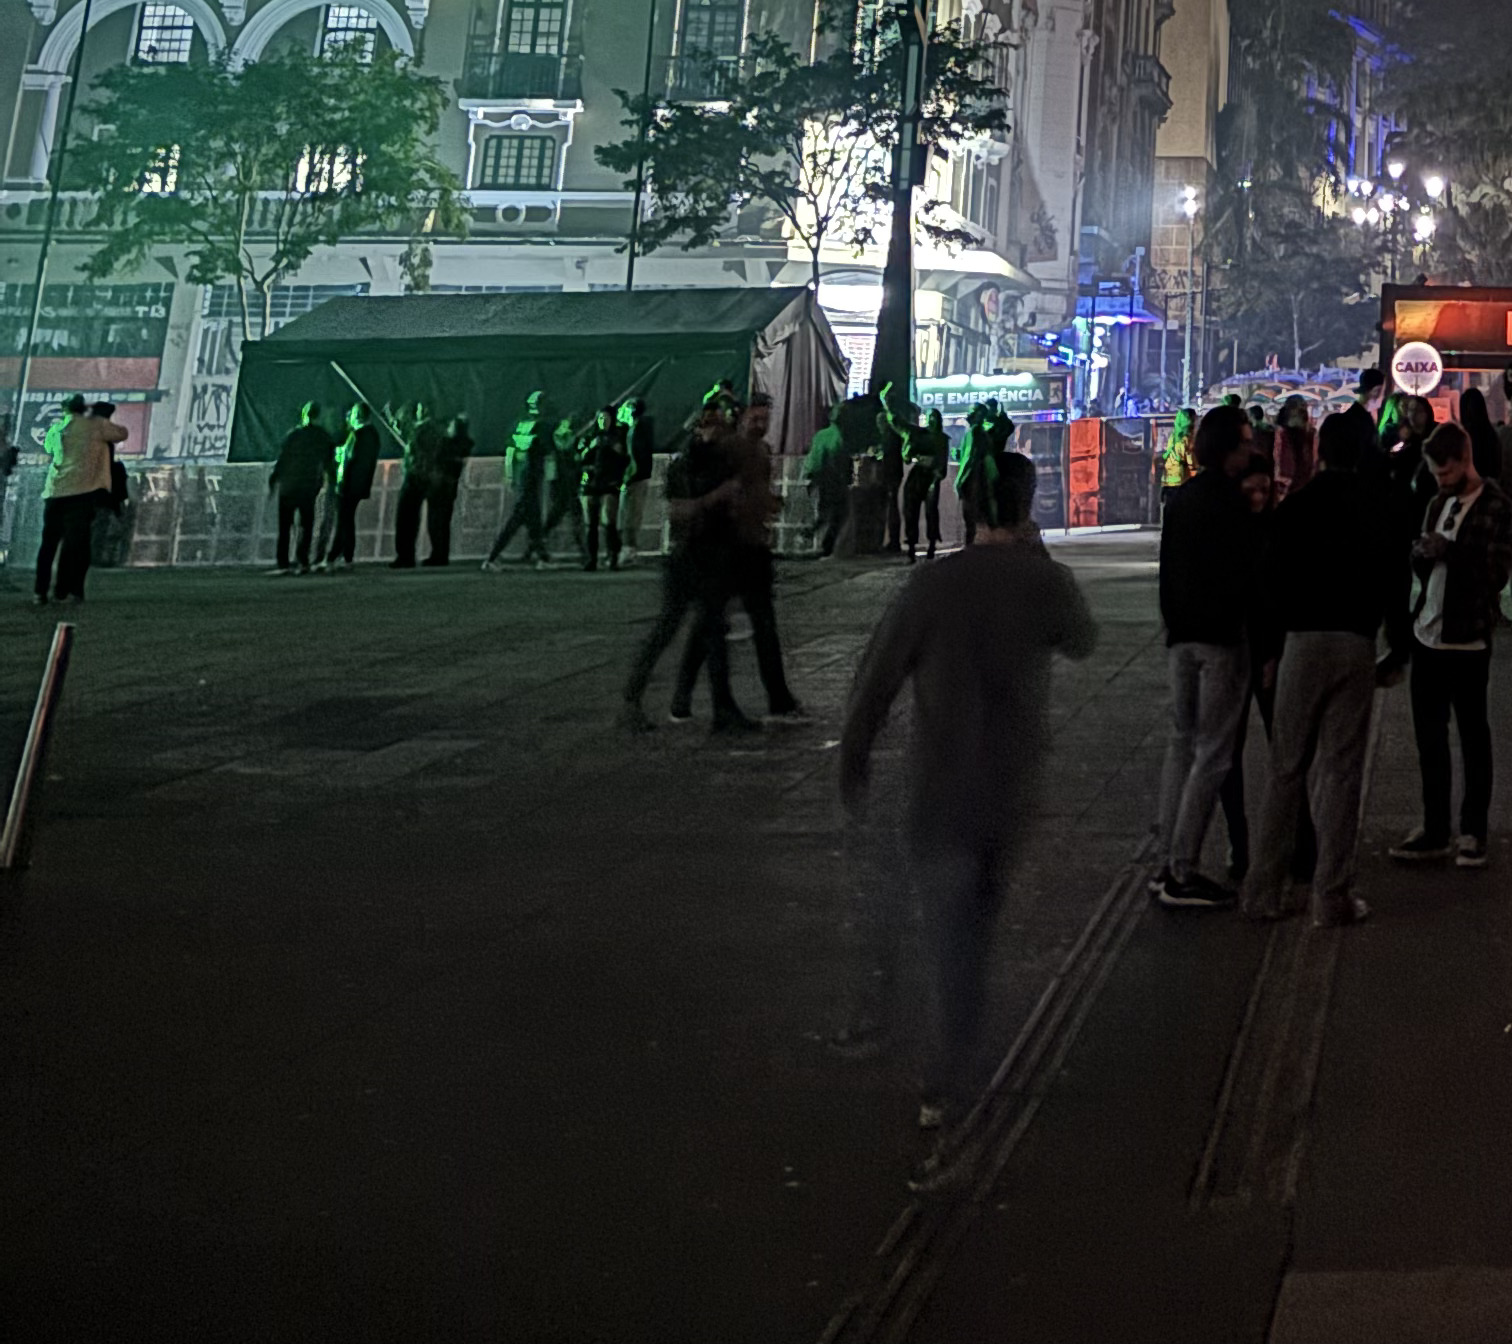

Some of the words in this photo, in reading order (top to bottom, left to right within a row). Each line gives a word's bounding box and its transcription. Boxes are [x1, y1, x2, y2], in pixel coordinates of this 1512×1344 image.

[1395, 361, 1438, 373] CAIXA
[923, 393, 944, 405] DE
[947, 387, 1043, 405] EMERGÊNCIA
